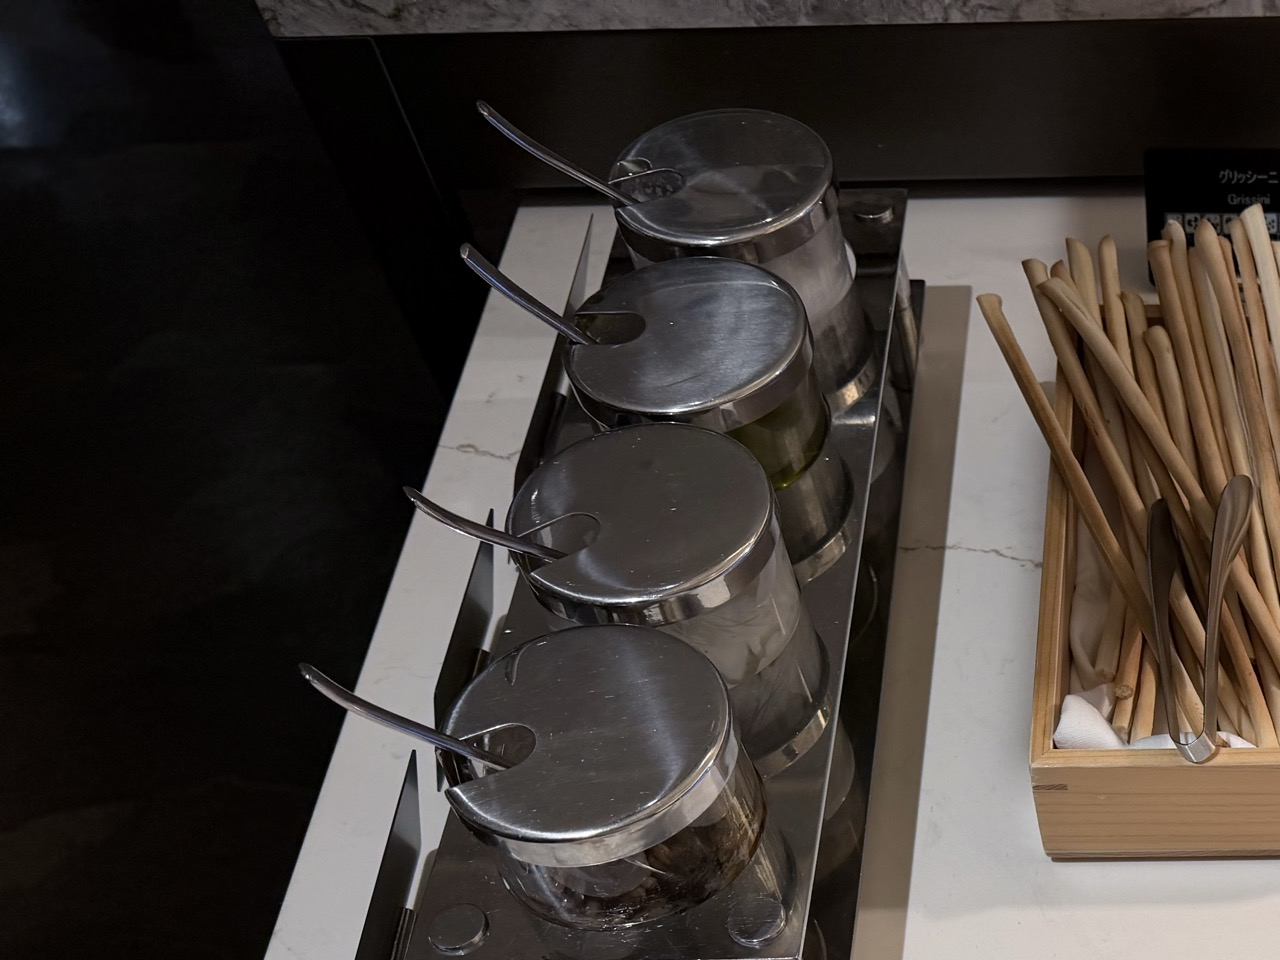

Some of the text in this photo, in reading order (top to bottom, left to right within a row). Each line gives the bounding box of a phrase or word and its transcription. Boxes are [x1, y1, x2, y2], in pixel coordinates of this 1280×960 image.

[1218, 168, 1279, 184] グリッシーニ
